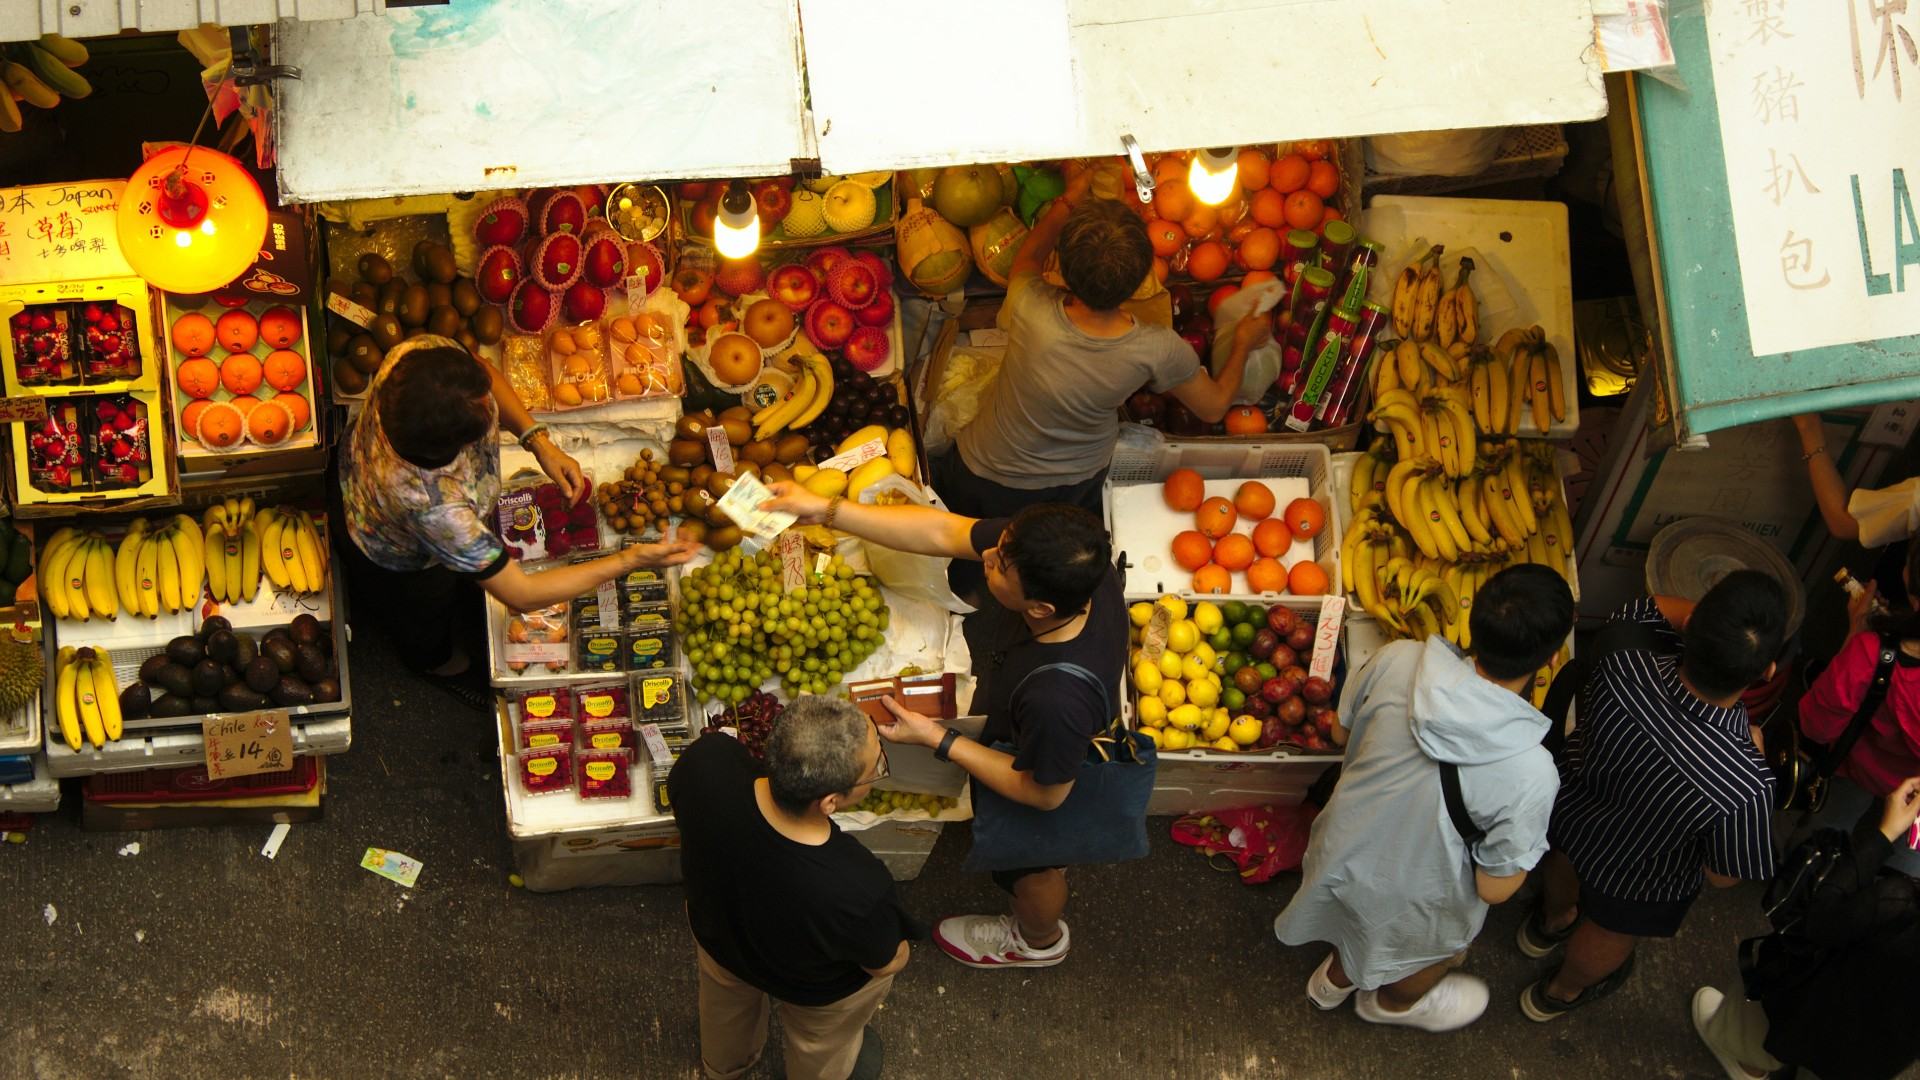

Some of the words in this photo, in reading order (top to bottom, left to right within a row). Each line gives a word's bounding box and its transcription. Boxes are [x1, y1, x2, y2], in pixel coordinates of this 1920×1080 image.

[46, 186, 113, 208] Japan
[81, 202, 119, 214] sweet
[1310, 348, 1335, 391] ROCKIT
[208, 719, 246, 736] Chile
[240, 741, 264, 759] 14
